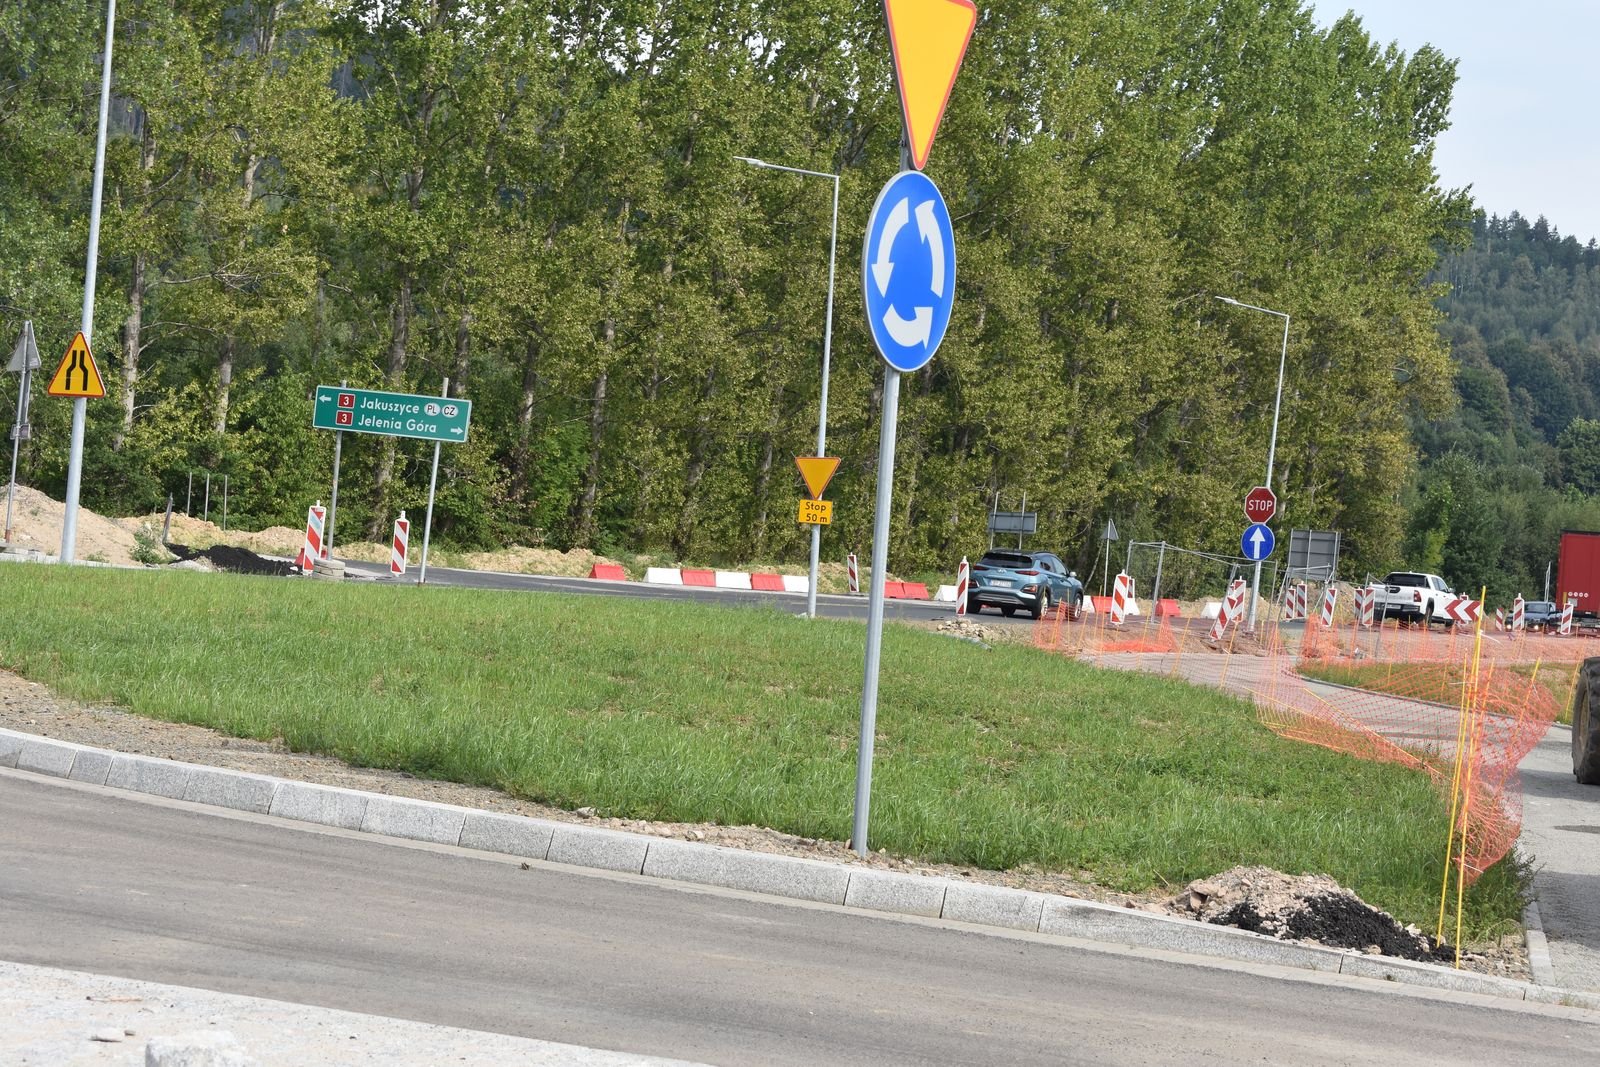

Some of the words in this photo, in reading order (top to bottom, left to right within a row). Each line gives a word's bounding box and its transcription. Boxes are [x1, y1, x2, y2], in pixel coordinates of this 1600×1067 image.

[343, 396, 350, 406] 3
[360, 396, 420, 415] Jakuszyce
[427, 404, 437, 415] PL
[444, 406, 455, 416] CZ
[341, 413, 348, 423] 3
[358, 413, 402, 430] Jelenia
[406, 418, 437, 433] Góra
[805, 502, 827, 513] Stop
[1248, 499, 1273, 512] STOP
[806, 513, 818, 522] 50
